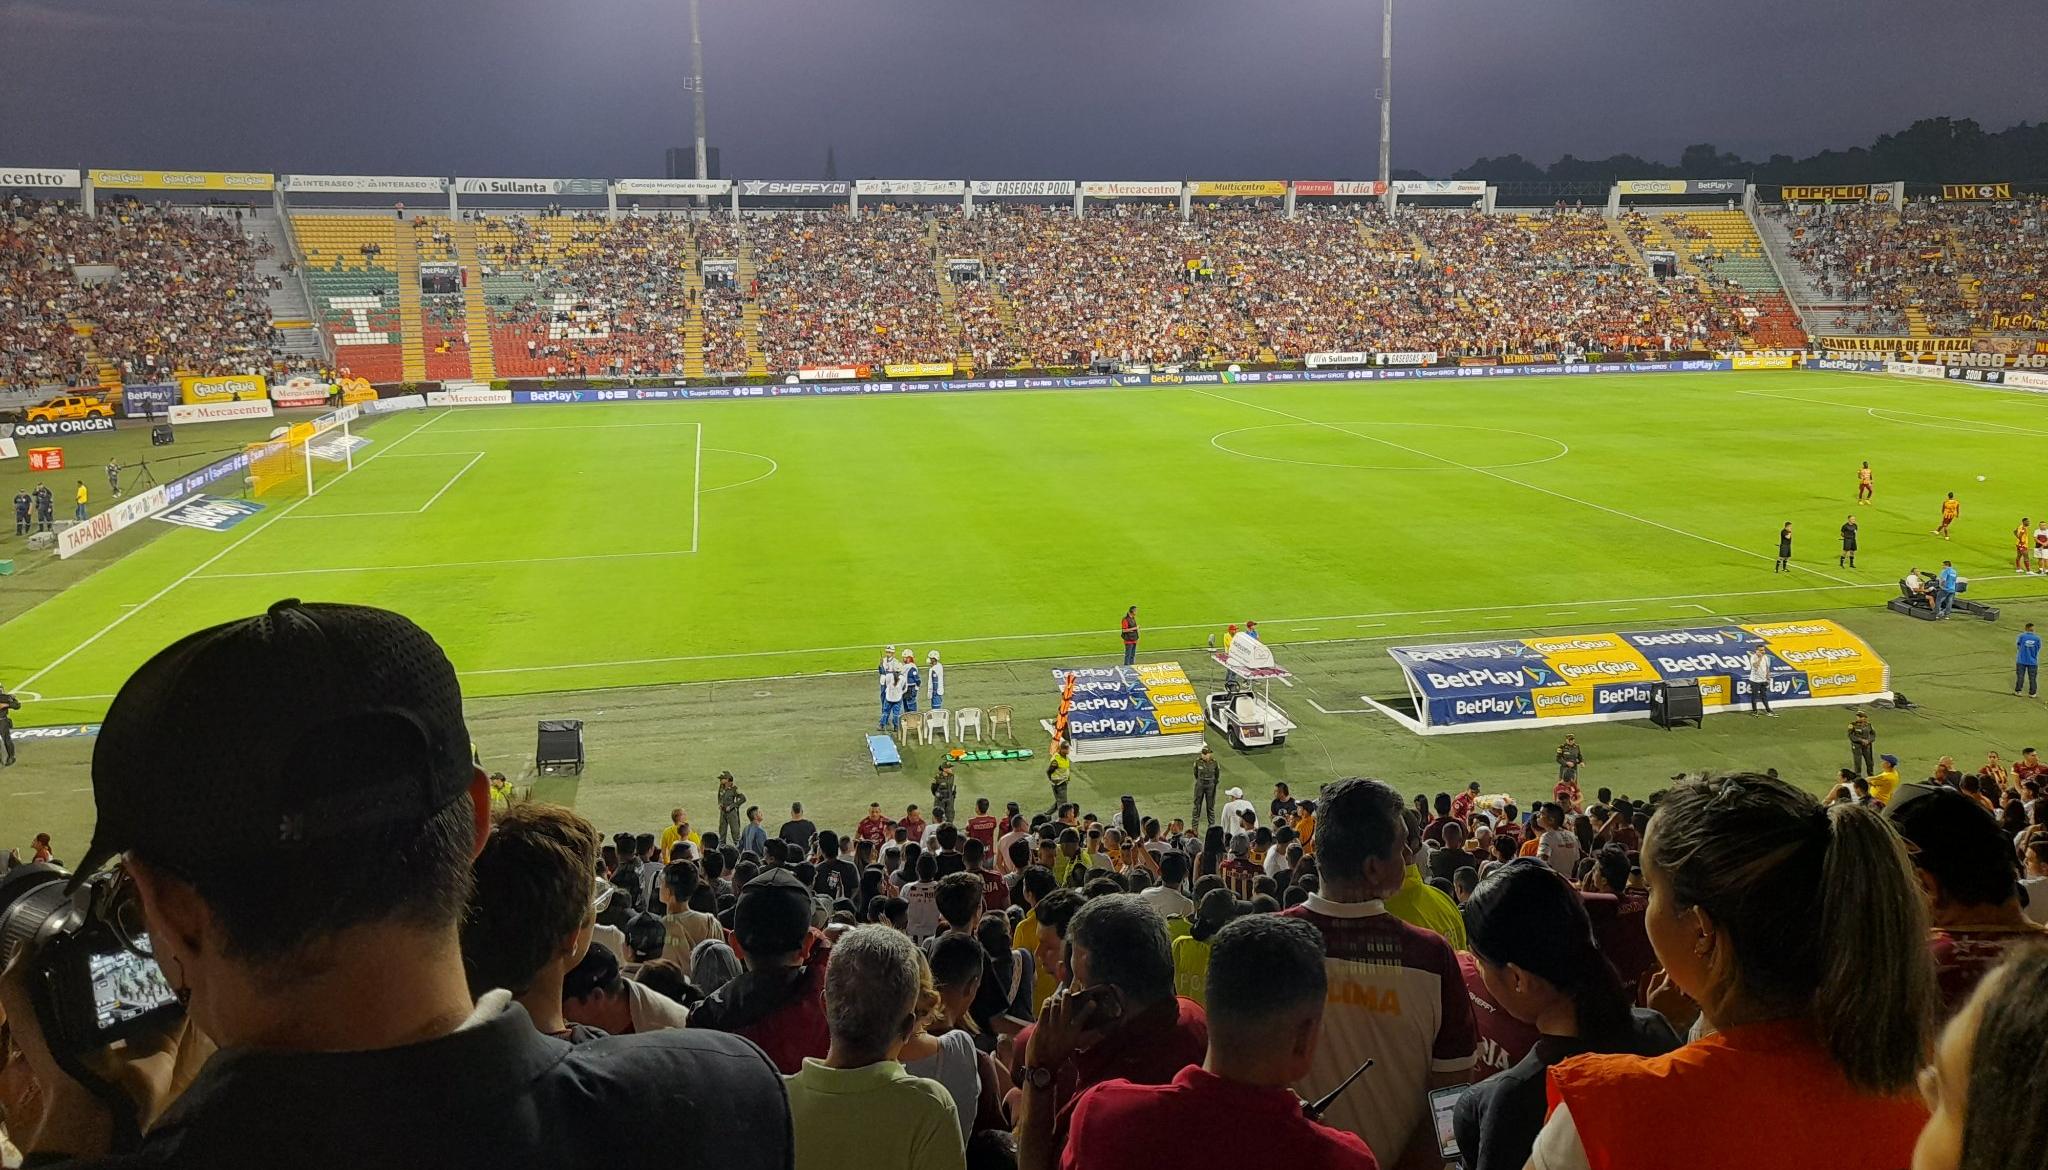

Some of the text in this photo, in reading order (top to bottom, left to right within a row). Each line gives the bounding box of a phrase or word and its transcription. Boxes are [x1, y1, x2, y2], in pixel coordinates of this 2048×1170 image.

[0, 173, 64, 186] centro
[303, 180, 354, 188] INTERASEO
[491, 181, 547, 193] Sullanta
[768, 183, 845, 193] SHEFFY.CO
[995, 182, 1071, 195] GASEOSAS POOL
[1107, 184, 1175, 195] Mercacentro
[1214, 183, 1265, 191] Multicentro
[1336, 184, 1352, 193] Al
[1355, 183, 1370, 194] día
[1698, 182, 1726, 190] BetPlay
[1783, 186, 1866, 200] TOPACIO
[421, 267, 448, 275] BetPlay
[1821, 337, 1970, 351] CANTA EL ALMA DE MI RAZA
[1328, 354, 1359, 363] Sullanta
[1391, 353, 1419, 364] GASEOSAS
[1933, 351, 2006, 367] TENGO
[2013, 353, 2048, 368] AG
[1682, 360, 1714, 371] BetPlay
[1819, 359, 1858, 371] BetPlay
[1123, 374, 1218, 385] LIGA BetPlay DIMAYOR
[1965, 369, 1983, 380] SODA
[2022, 374, 2048, 385] Mercac
[127, 390, 165, 401] BetPlay
[449, 393, 507, 403] Mercacentro
[530, 390, 572, 402] BetPlay
[196, 405, 268, 418] Mercacentro
[15, 417, 114, 436] GOLTY ORIGEN
[67, 512, 113, 550] TAPA ROJA
[1632, 630, 1724, 647] BetPlay
[1410, 644, 1502, 662] BetPlay
[1658, 651, 1752, 673] BetPlay
[1427, 667, 1525, 689] BetPlay
[1736, 677, 1791, 696] Belay
[1455, 697, 1514, 716] BetPlay
[1071, 718, 1136, 735] BetPlay
